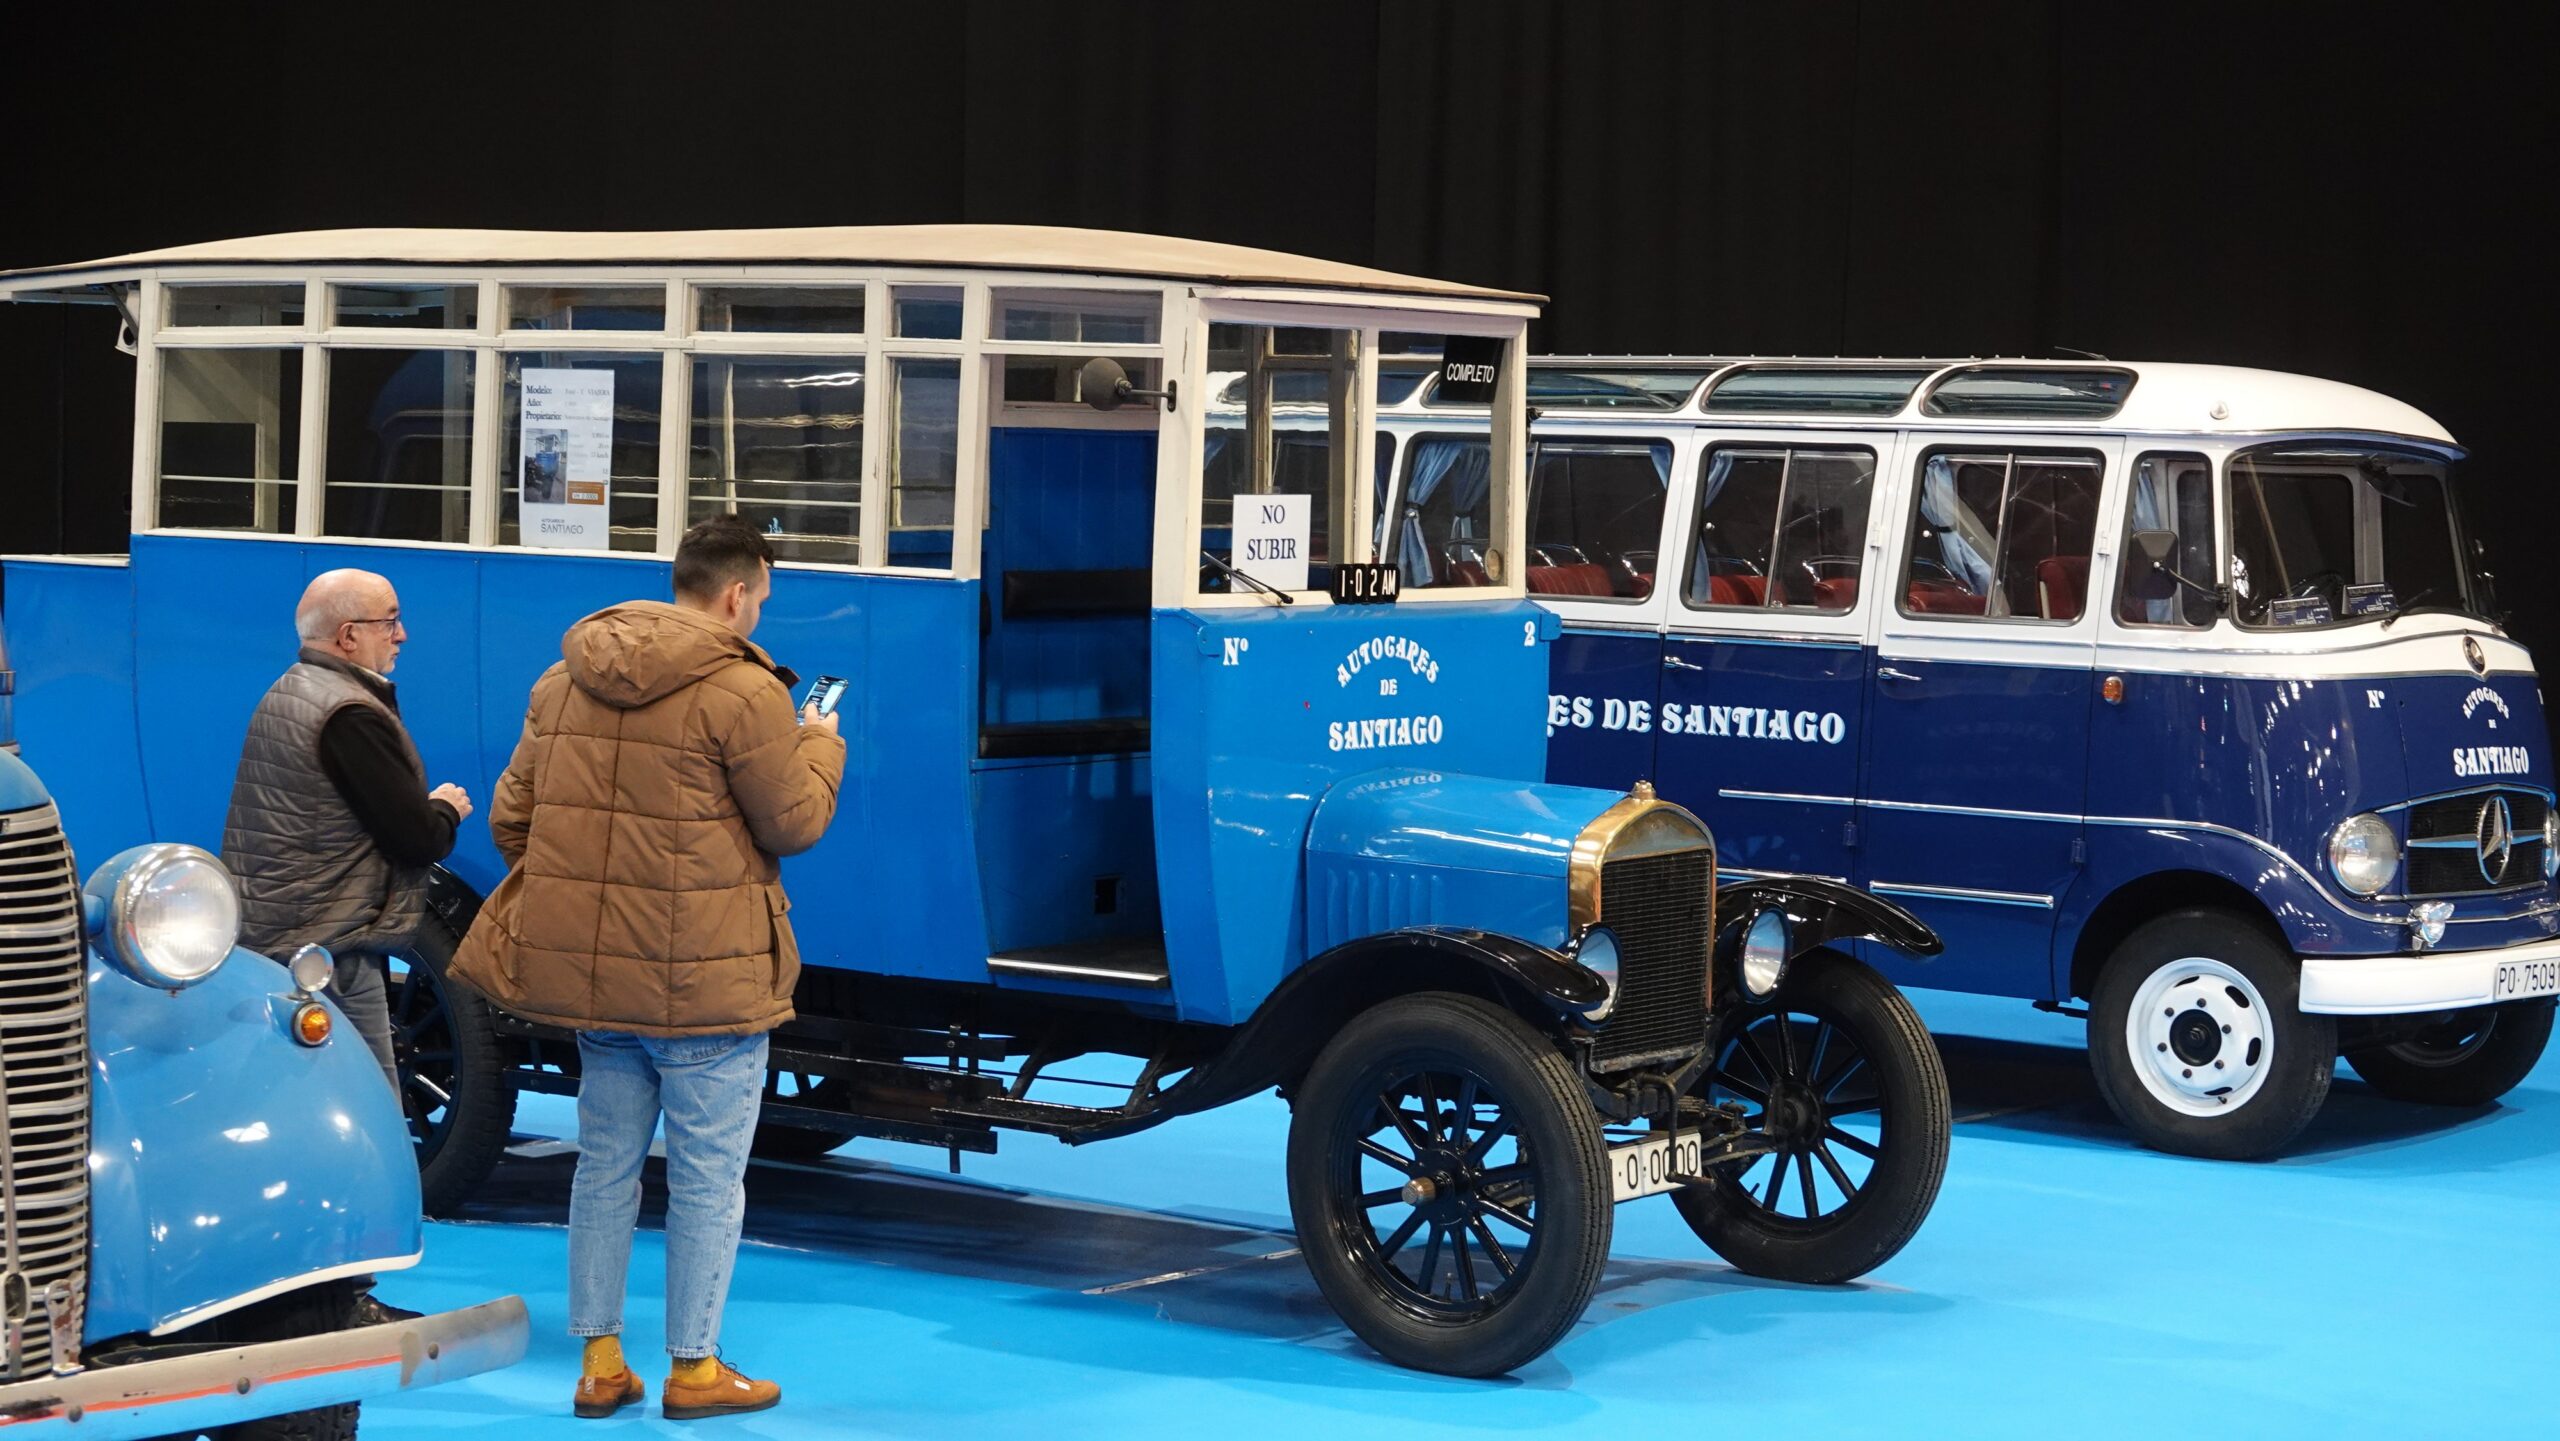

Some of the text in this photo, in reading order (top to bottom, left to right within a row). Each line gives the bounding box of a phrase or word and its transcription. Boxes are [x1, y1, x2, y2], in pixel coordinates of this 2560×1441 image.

[1446, 362, 1495, 383] COMPLETO
[1261, 504, 1285, 524] NO
[540, 523, 584, 535] SANTIAGO
[1247, 538, 1296, 560] SUBIR
[1524, 621, 1536, 647] 2
[1380, 678, 1398, 696] DE
[1547, 694, 1846, 745] ES DE SANTIAGO
[1328, 715, 1443, 752] SANTIAGO
[2453, 746, 2530, 778] SANTIAGO
